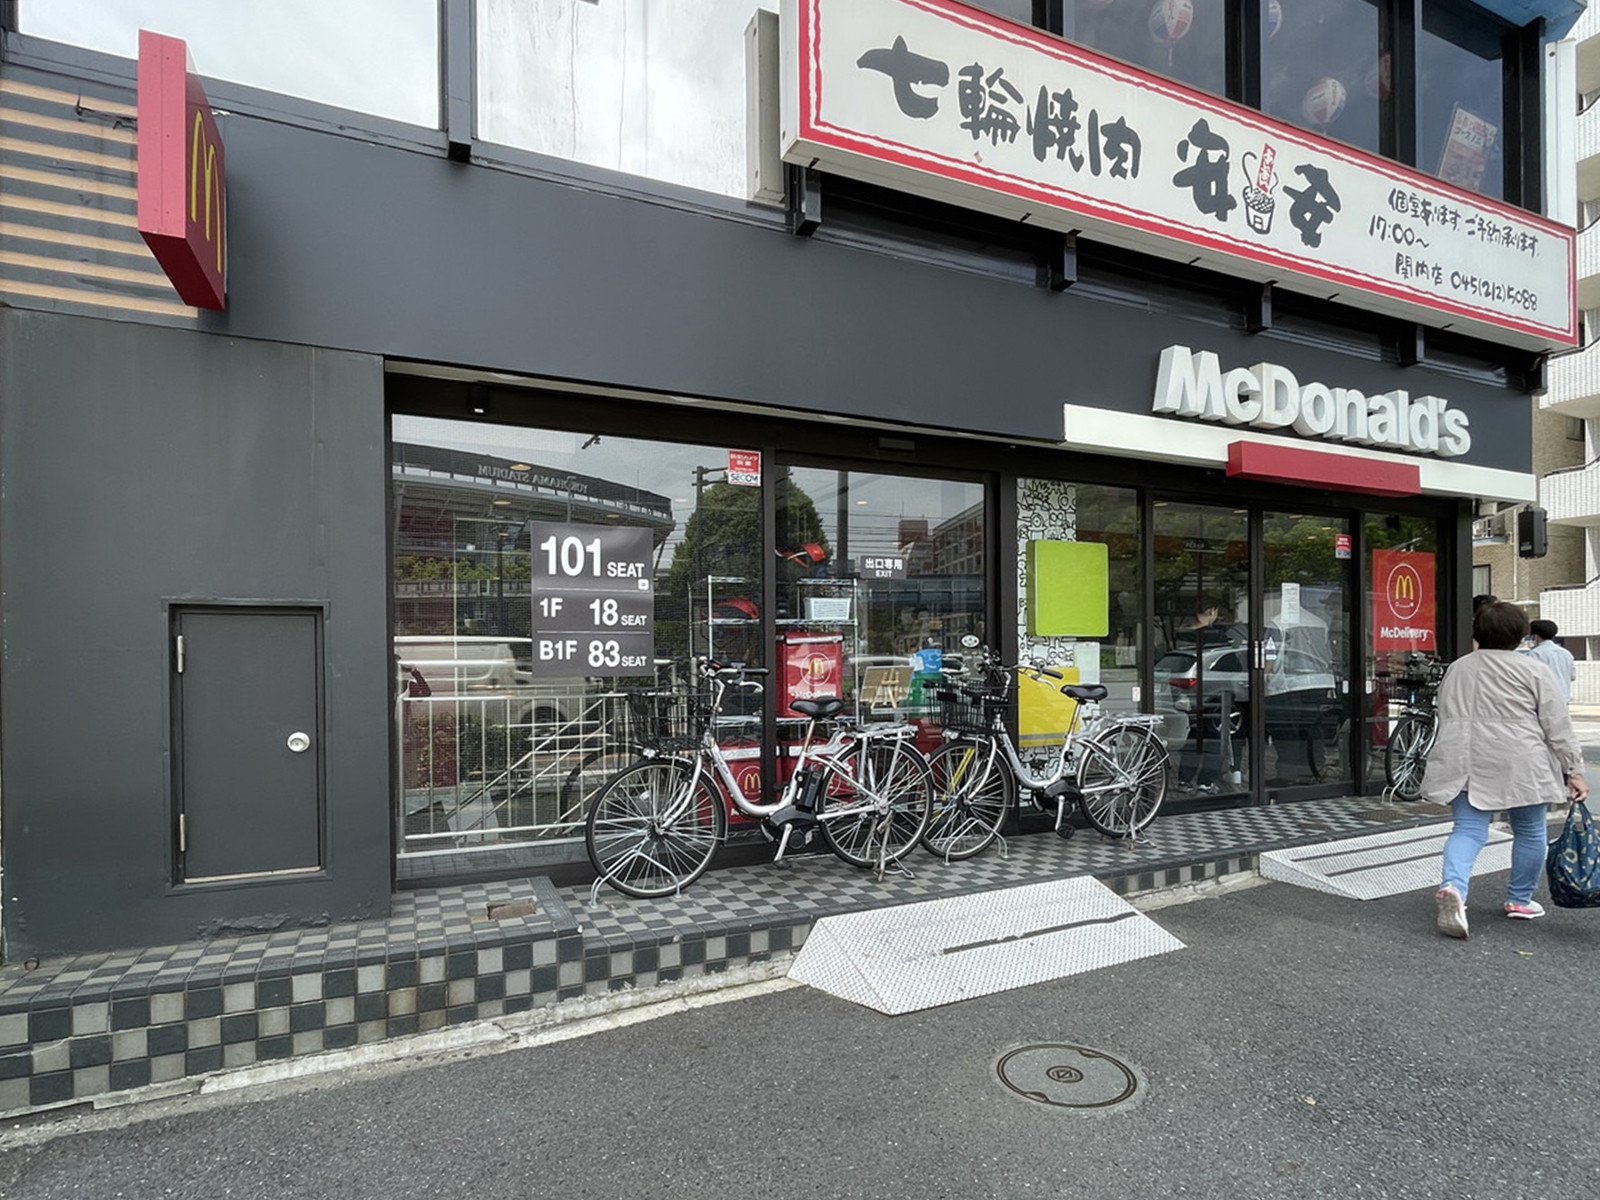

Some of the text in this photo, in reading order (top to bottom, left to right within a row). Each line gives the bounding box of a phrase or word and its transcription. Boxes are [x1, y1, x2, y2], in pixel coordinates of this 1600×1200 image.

[856, 35, 1142, 179] 七輪焼肉
[1451, 271, 1538, 311] 045(212)5088
[1152, 344, 1471, 457] McDonald's
[541, 536, 645, 578] 101 SEAT
[865, 557, 903, 570] 出口専用
[540, 598, 647, 626] 1F 18 SEAT
[1380, 626, 1429, 642] McDelivery
[540, 640, 647, 667] B1F 83 SEAT
